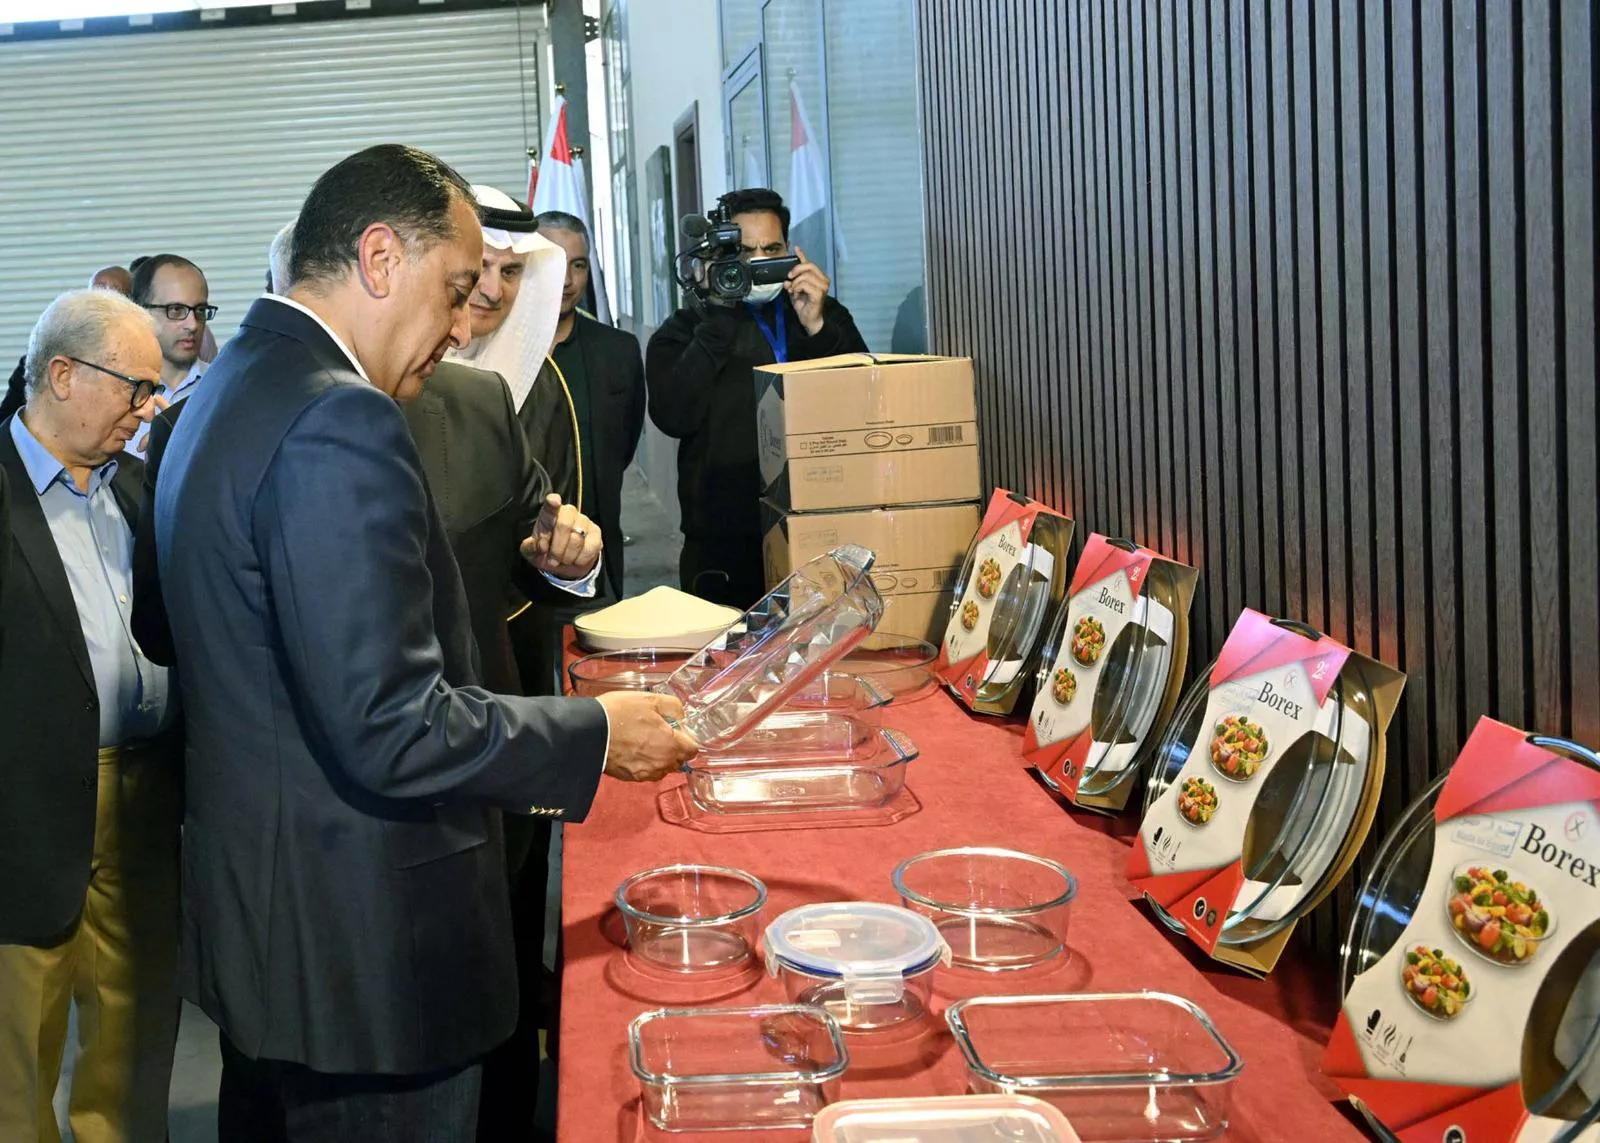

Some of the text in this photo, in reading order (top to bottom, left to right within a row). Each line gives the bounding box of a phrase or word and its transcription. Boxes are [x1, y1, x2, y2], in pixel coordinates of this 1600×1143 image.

[1098, 587, 1125, 614] Borex
[1257, 681, 1303, 720] Borex
[1520, 823, 1600, 888] Borex
